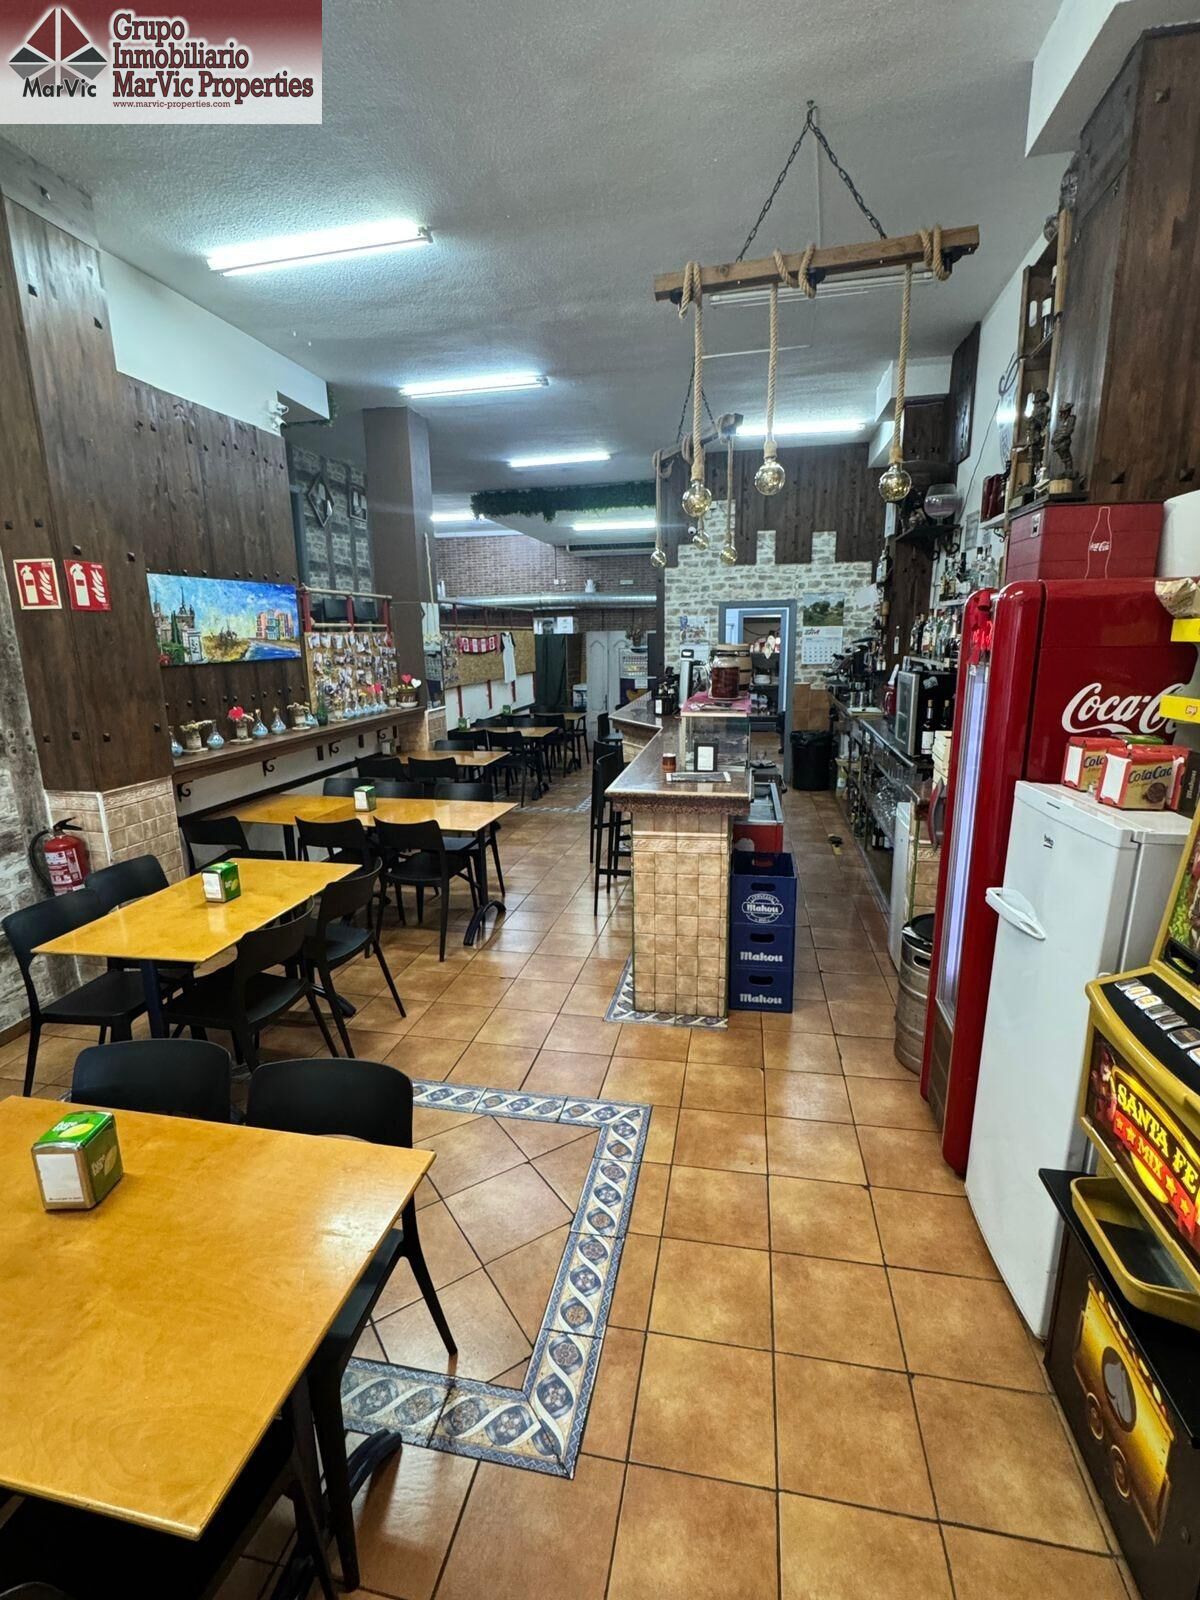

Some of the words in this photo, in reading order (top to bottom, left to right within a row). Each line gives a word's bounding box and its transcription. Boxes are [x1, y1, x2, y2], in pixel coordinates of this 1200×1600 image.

[747, 904, 779, 913] Mahou
[740, 951, 783, 962] Mahou
[739, 993, 782, 1005] Mahou
[1117, 1083, 1170, 1158] SANTA
[1172, 1146, 1199, 1195] FE
[1137, 1136, 1164, 1181] MIX
